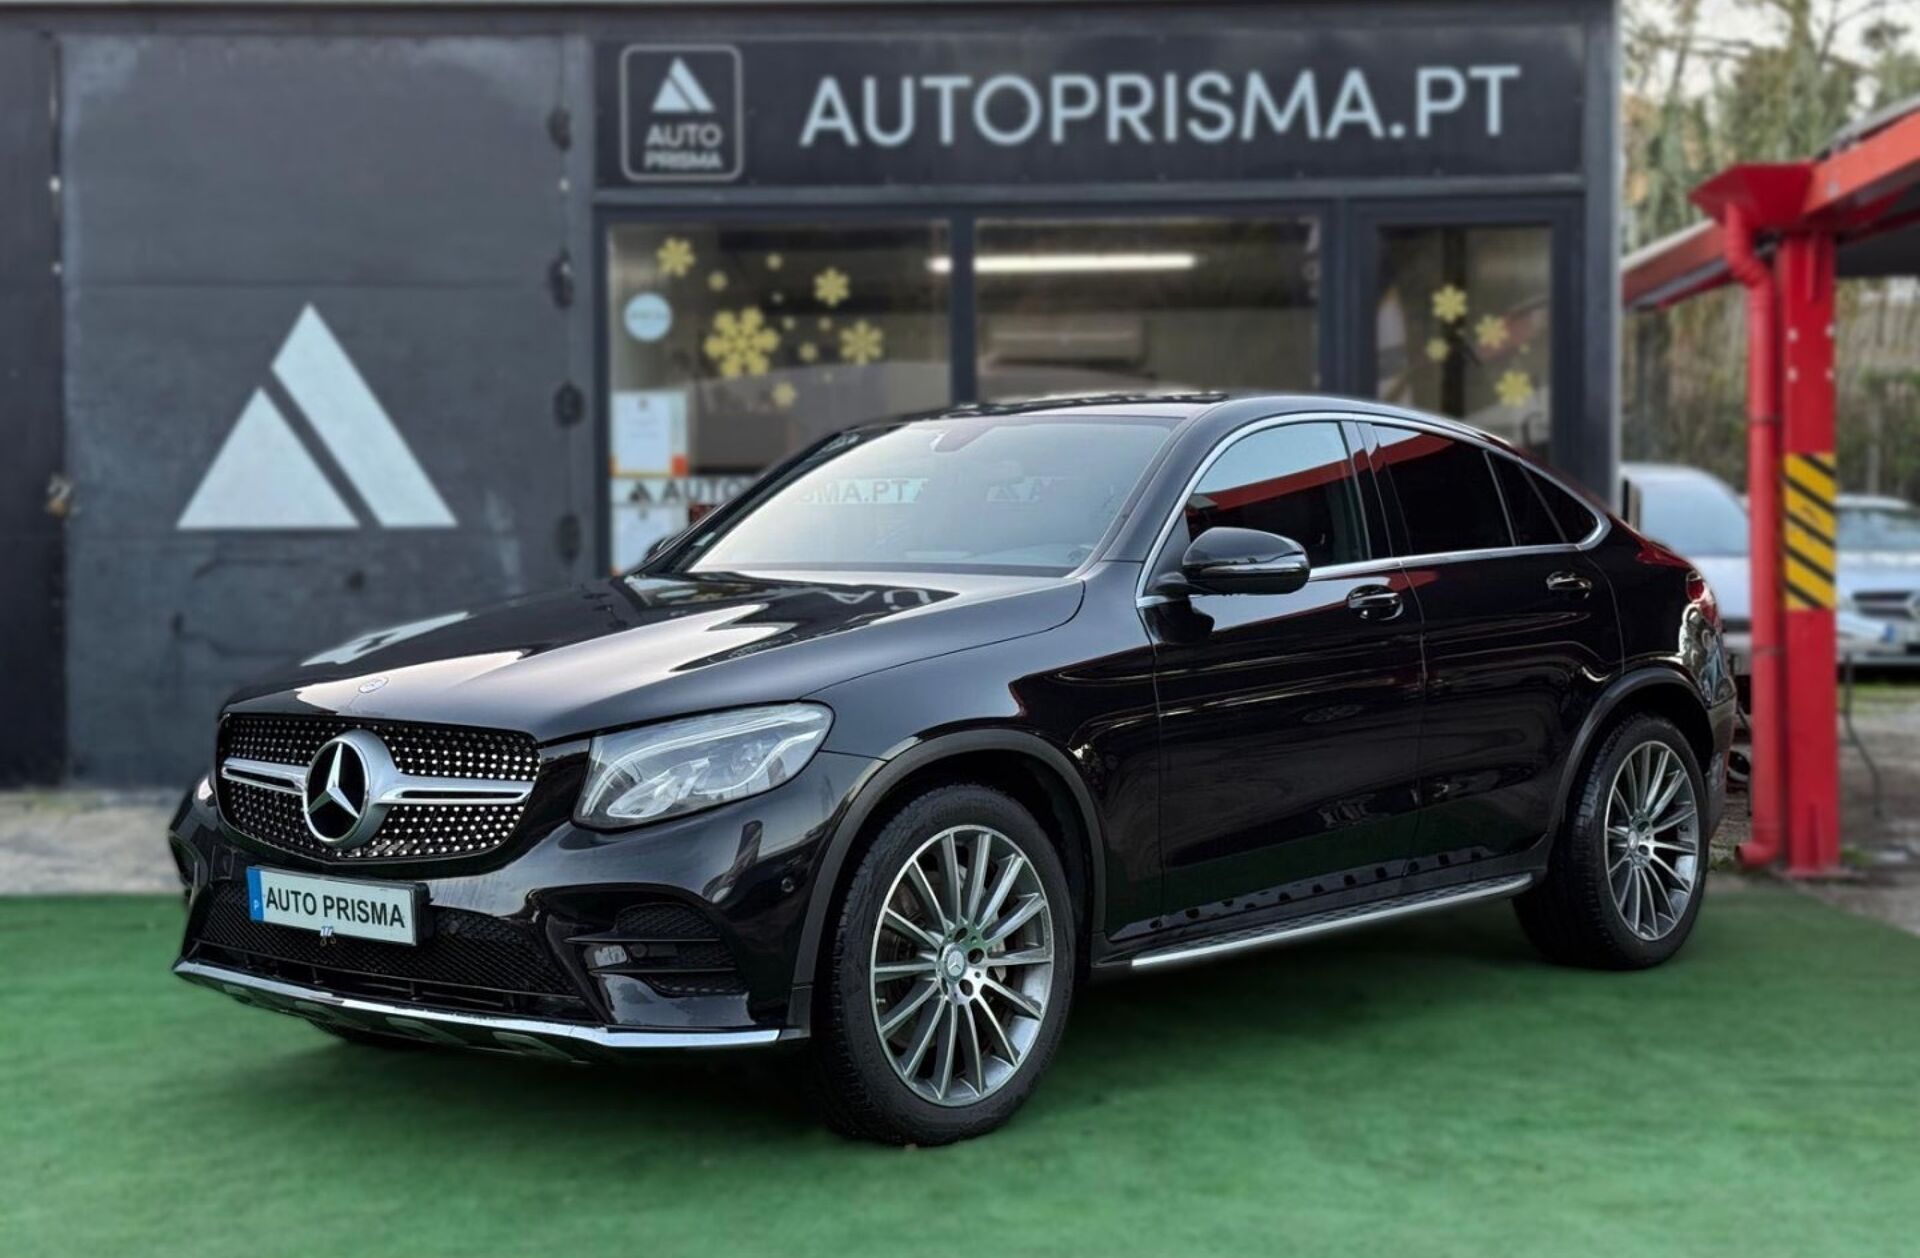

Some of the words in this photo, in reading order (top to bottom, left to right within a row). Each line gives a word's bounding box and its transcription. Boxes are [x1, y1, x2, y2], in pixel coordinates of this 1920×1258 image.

[799, 64, 1521, 148] AUTOPRISMA.PT
[645, 122, 723, 148] AUTO
[644, 149, 723, 170] PRISMA
[265, 886, 318, 917] AUTO
[323, 894, 405, 929] PRISMA
